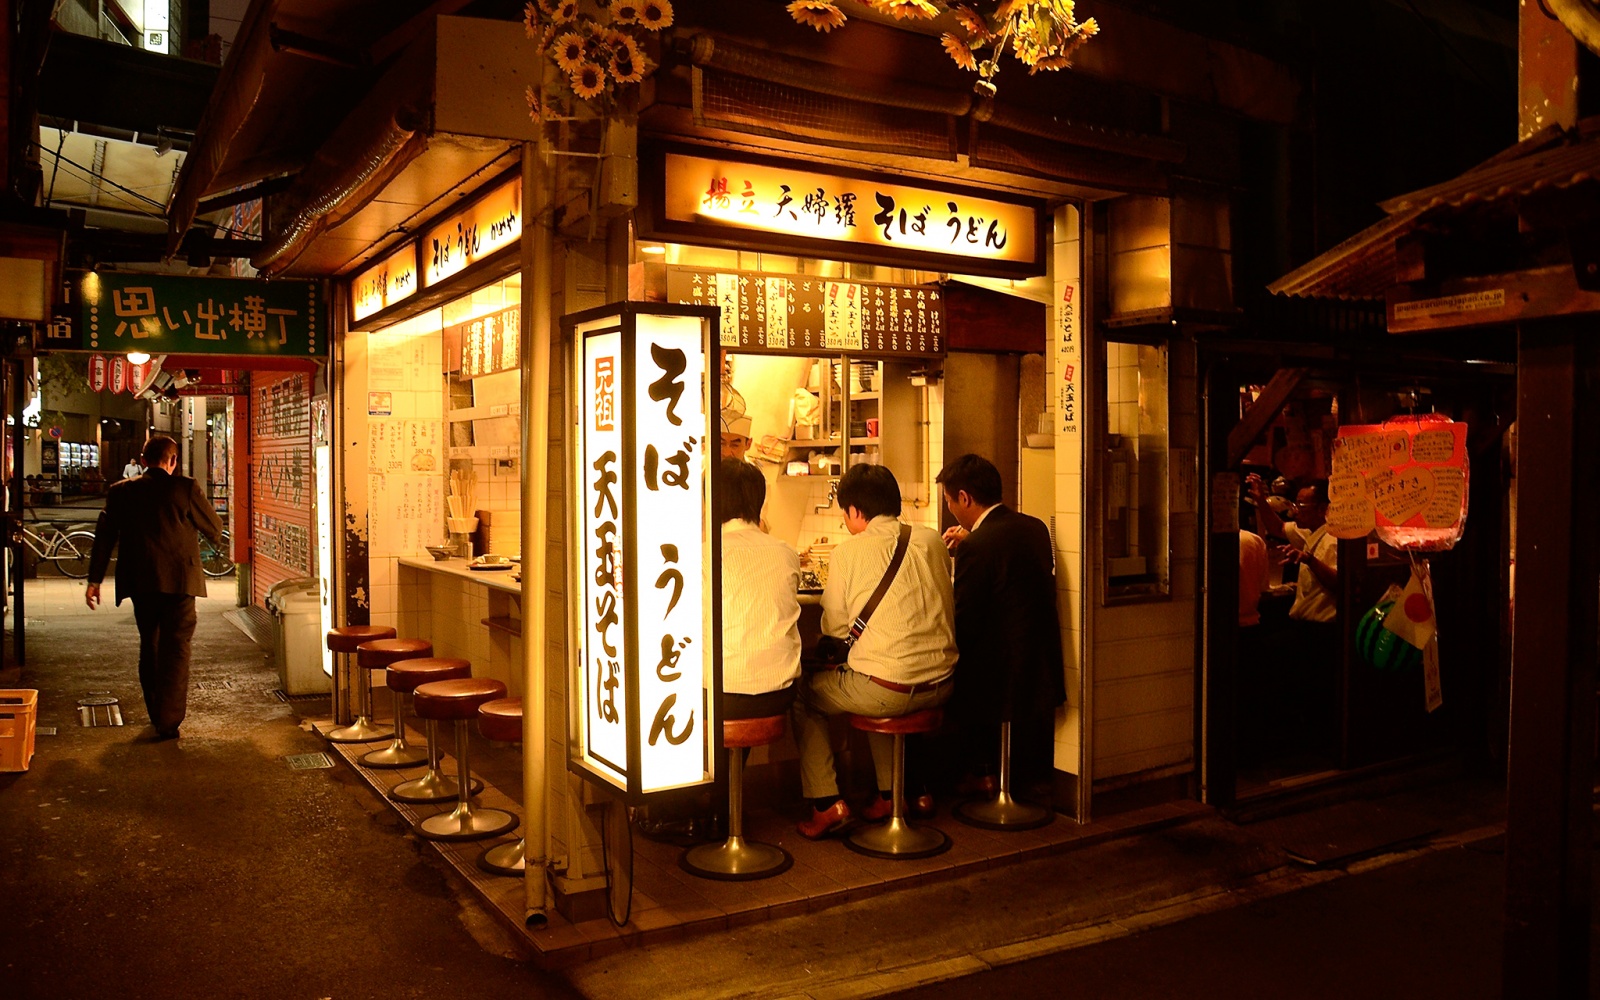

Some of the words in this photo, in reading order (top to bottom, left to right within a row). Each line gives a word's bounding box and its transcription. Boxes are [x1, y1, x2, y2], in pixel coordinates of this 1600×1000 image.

[773, 184, 858, 228] 天婦羅
[873, 191, 931, 241] そば
[946, 201, 1007, 250] うどん
[433, 234, 451, 277] そば
[457, 222, 481, 260] うどん
[113, 286, 298, 345] 思い出横丁
[723, 293, 734, 334] 天玉そば
[787, 280, 796, 315] 大もり
[803, 281, 811, 313] ざる
[861, 286, 870, 316] きつね
[875, 287, 884, 316] わかめ
[903, 289, 912, 318] 玉子
[917, 290, 925, 319] たぬき
[930, 291, 939, 319] かけ
[847, 300, 858, 338] 天玉そば
[595, 361, 614, 428] 元祖
[1065, 384, 1075, 422] 天玉そば
[643, 342, 697, 491] そば
[648, 543, 695, 747] うどん
